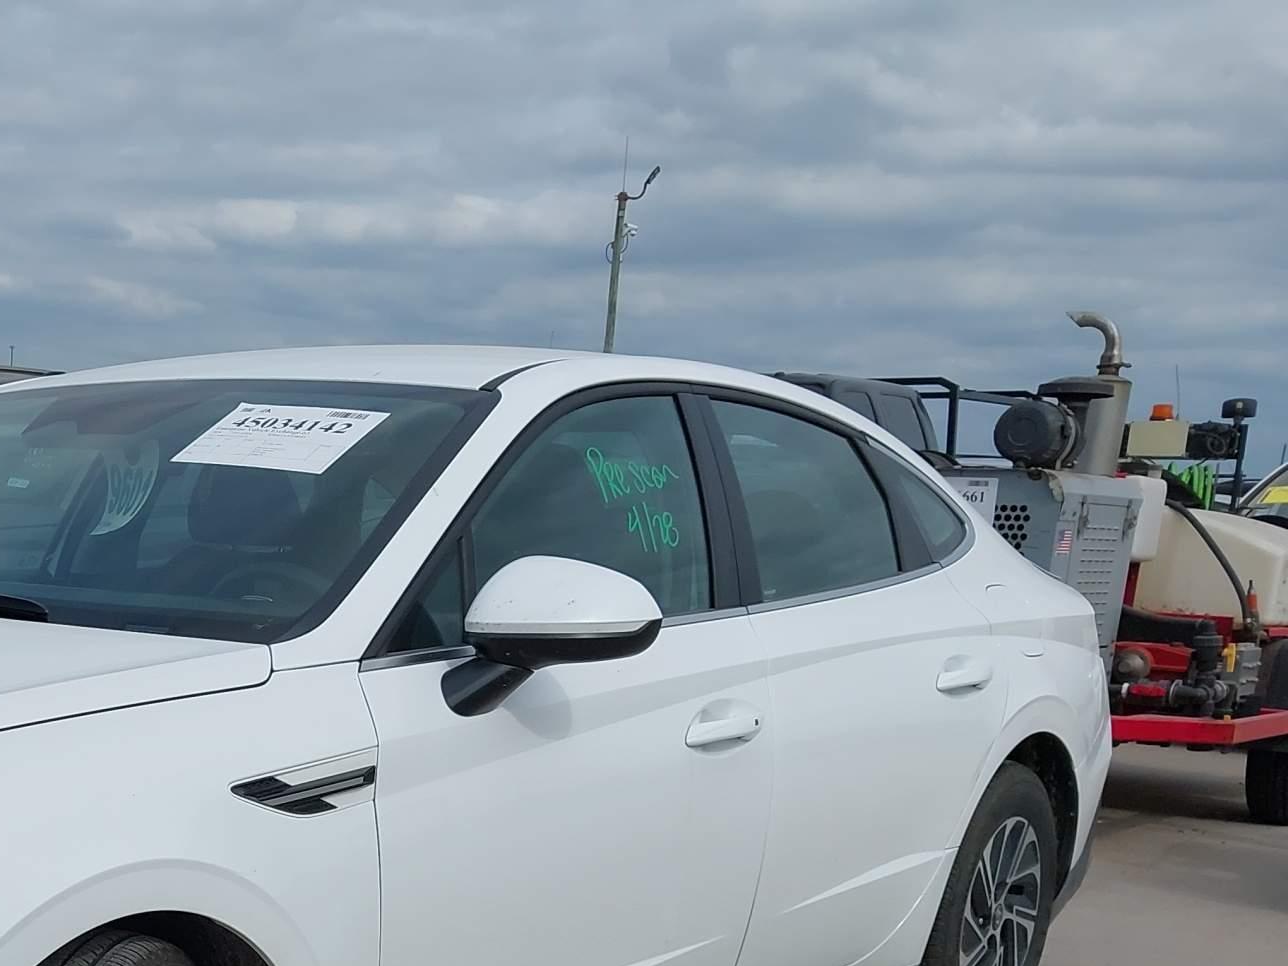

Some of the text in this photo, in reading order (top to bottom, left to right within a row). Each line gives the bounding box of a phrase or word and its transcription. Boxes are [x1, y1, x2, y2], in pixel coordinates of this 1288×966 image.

[232, 416, 353, 434] 45034142
[957, 490, 985, 503] 661
[627, 502, 679, 553] 4/28
